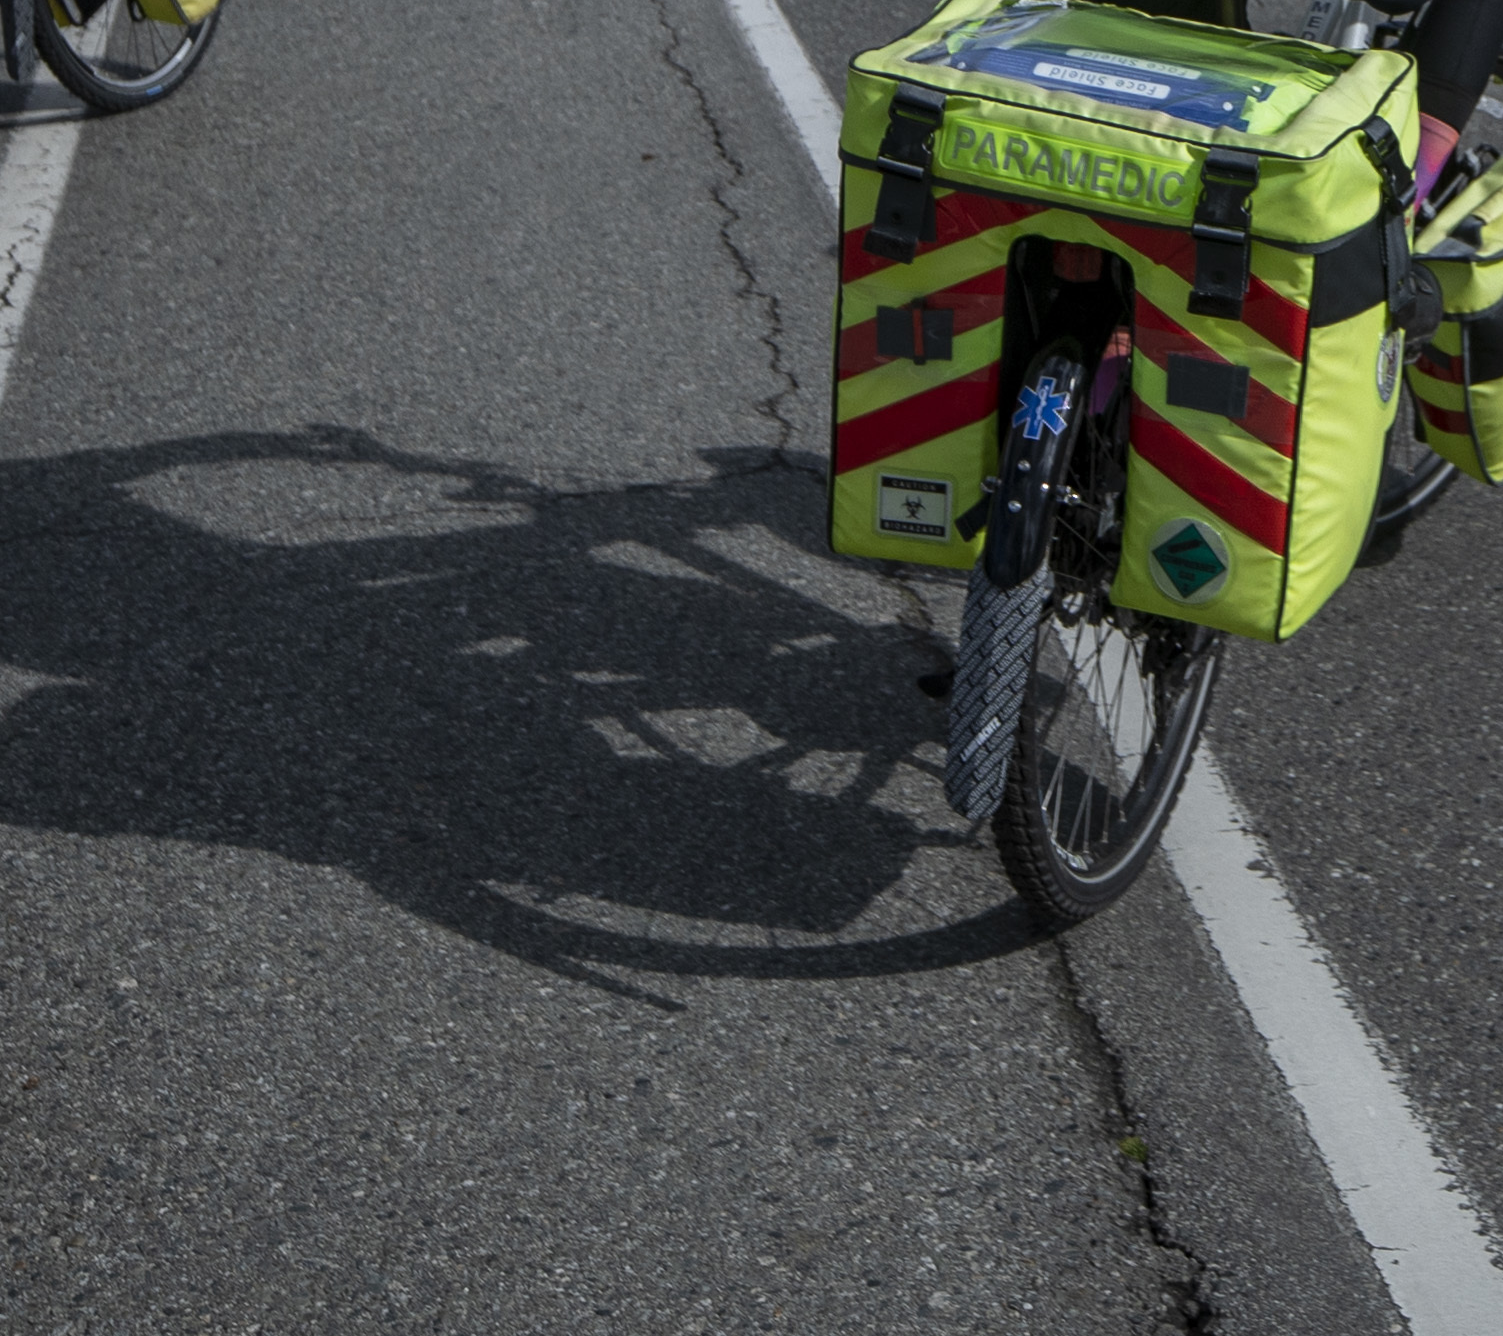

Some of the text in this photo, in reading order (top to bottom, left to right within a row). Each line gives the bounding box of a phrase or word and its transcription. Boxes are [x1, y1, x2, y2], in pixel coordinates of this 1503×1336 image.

[1049, 66, 1108, 87] Shield
[1115, 78, 1158, 96] Face
[952, 127, 1186, 207] PARAMEDIC
[891, 479, 937, 491] CAUTION
[883, 521, 942, 535] BIOHAZARD
